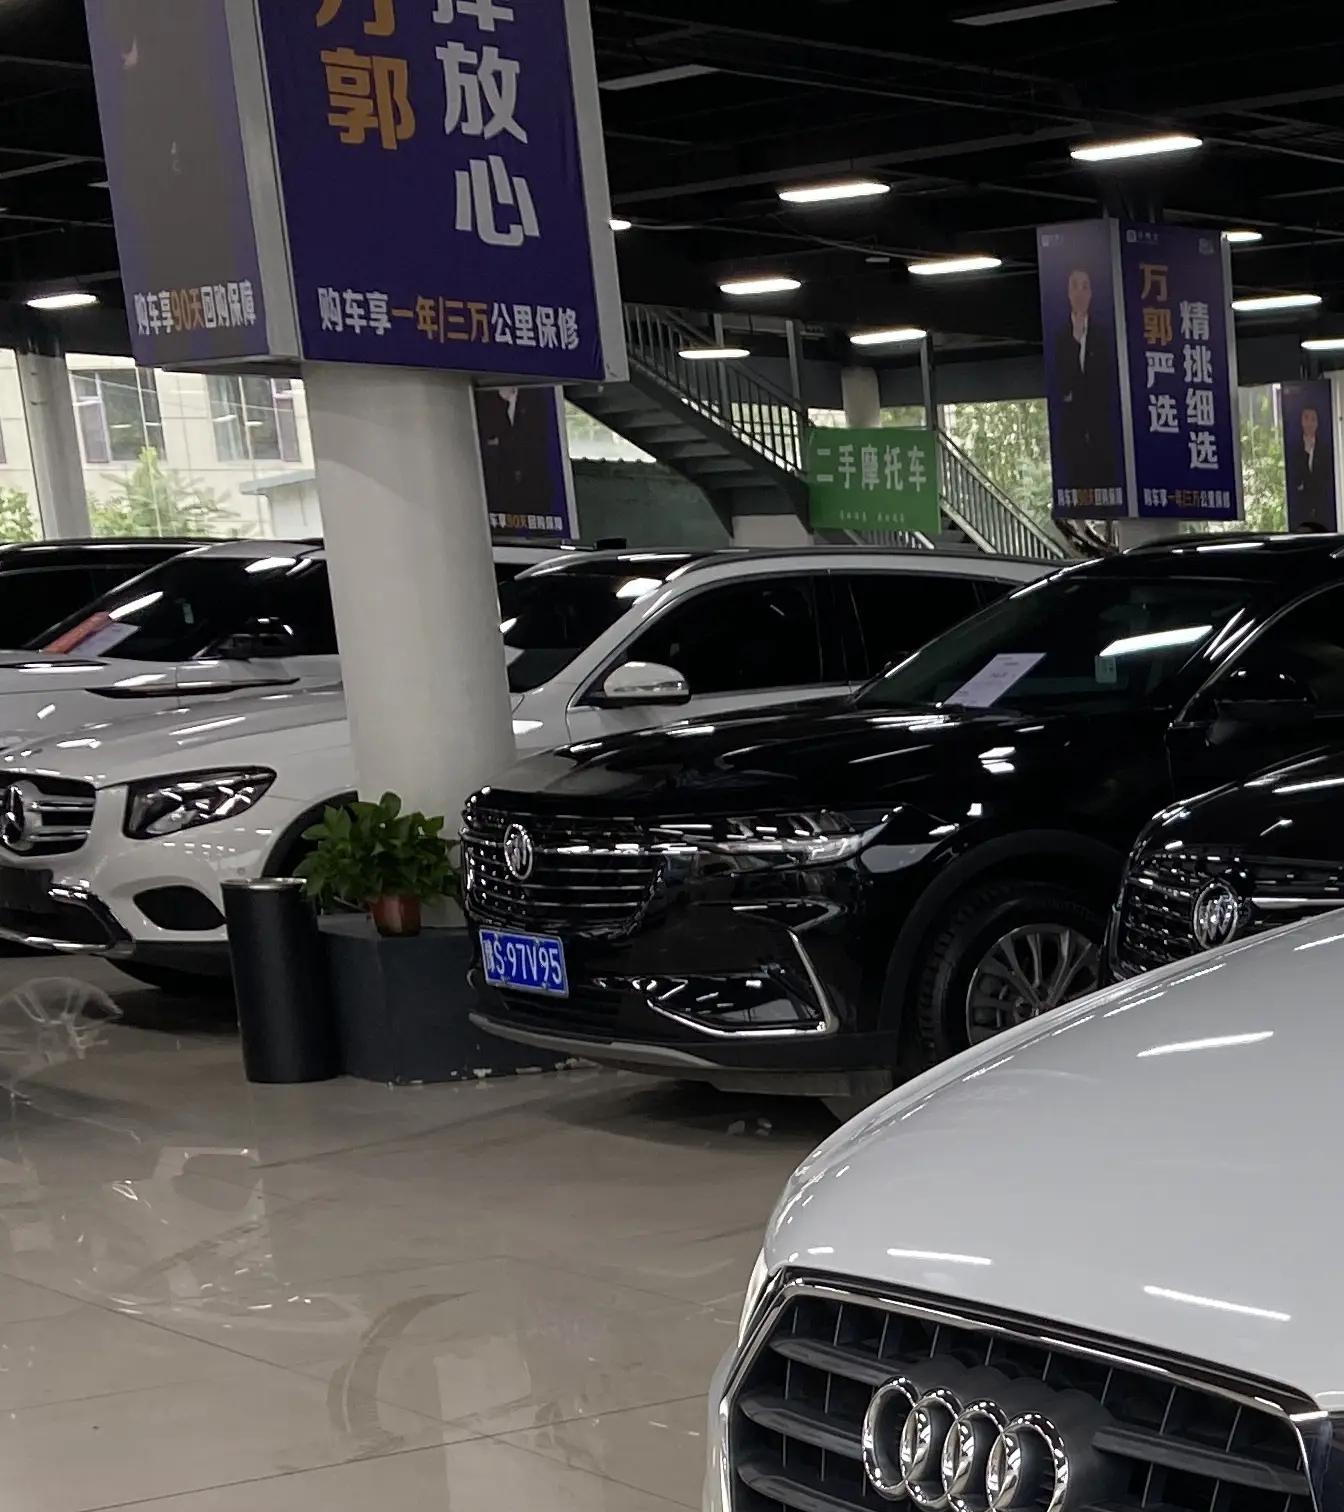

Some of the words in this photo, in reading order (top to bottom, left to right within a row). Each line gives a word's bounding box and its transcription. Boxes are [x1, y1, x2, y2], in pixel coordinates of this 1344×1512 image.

[134, 279, 256, 335] 购车享90天回购保障
[1139, 262, 1180, 434] 万郭严选
[1179, 299, 1219, 470] 精挑细选
[816, 443, 927, 492] 二手摩托车
